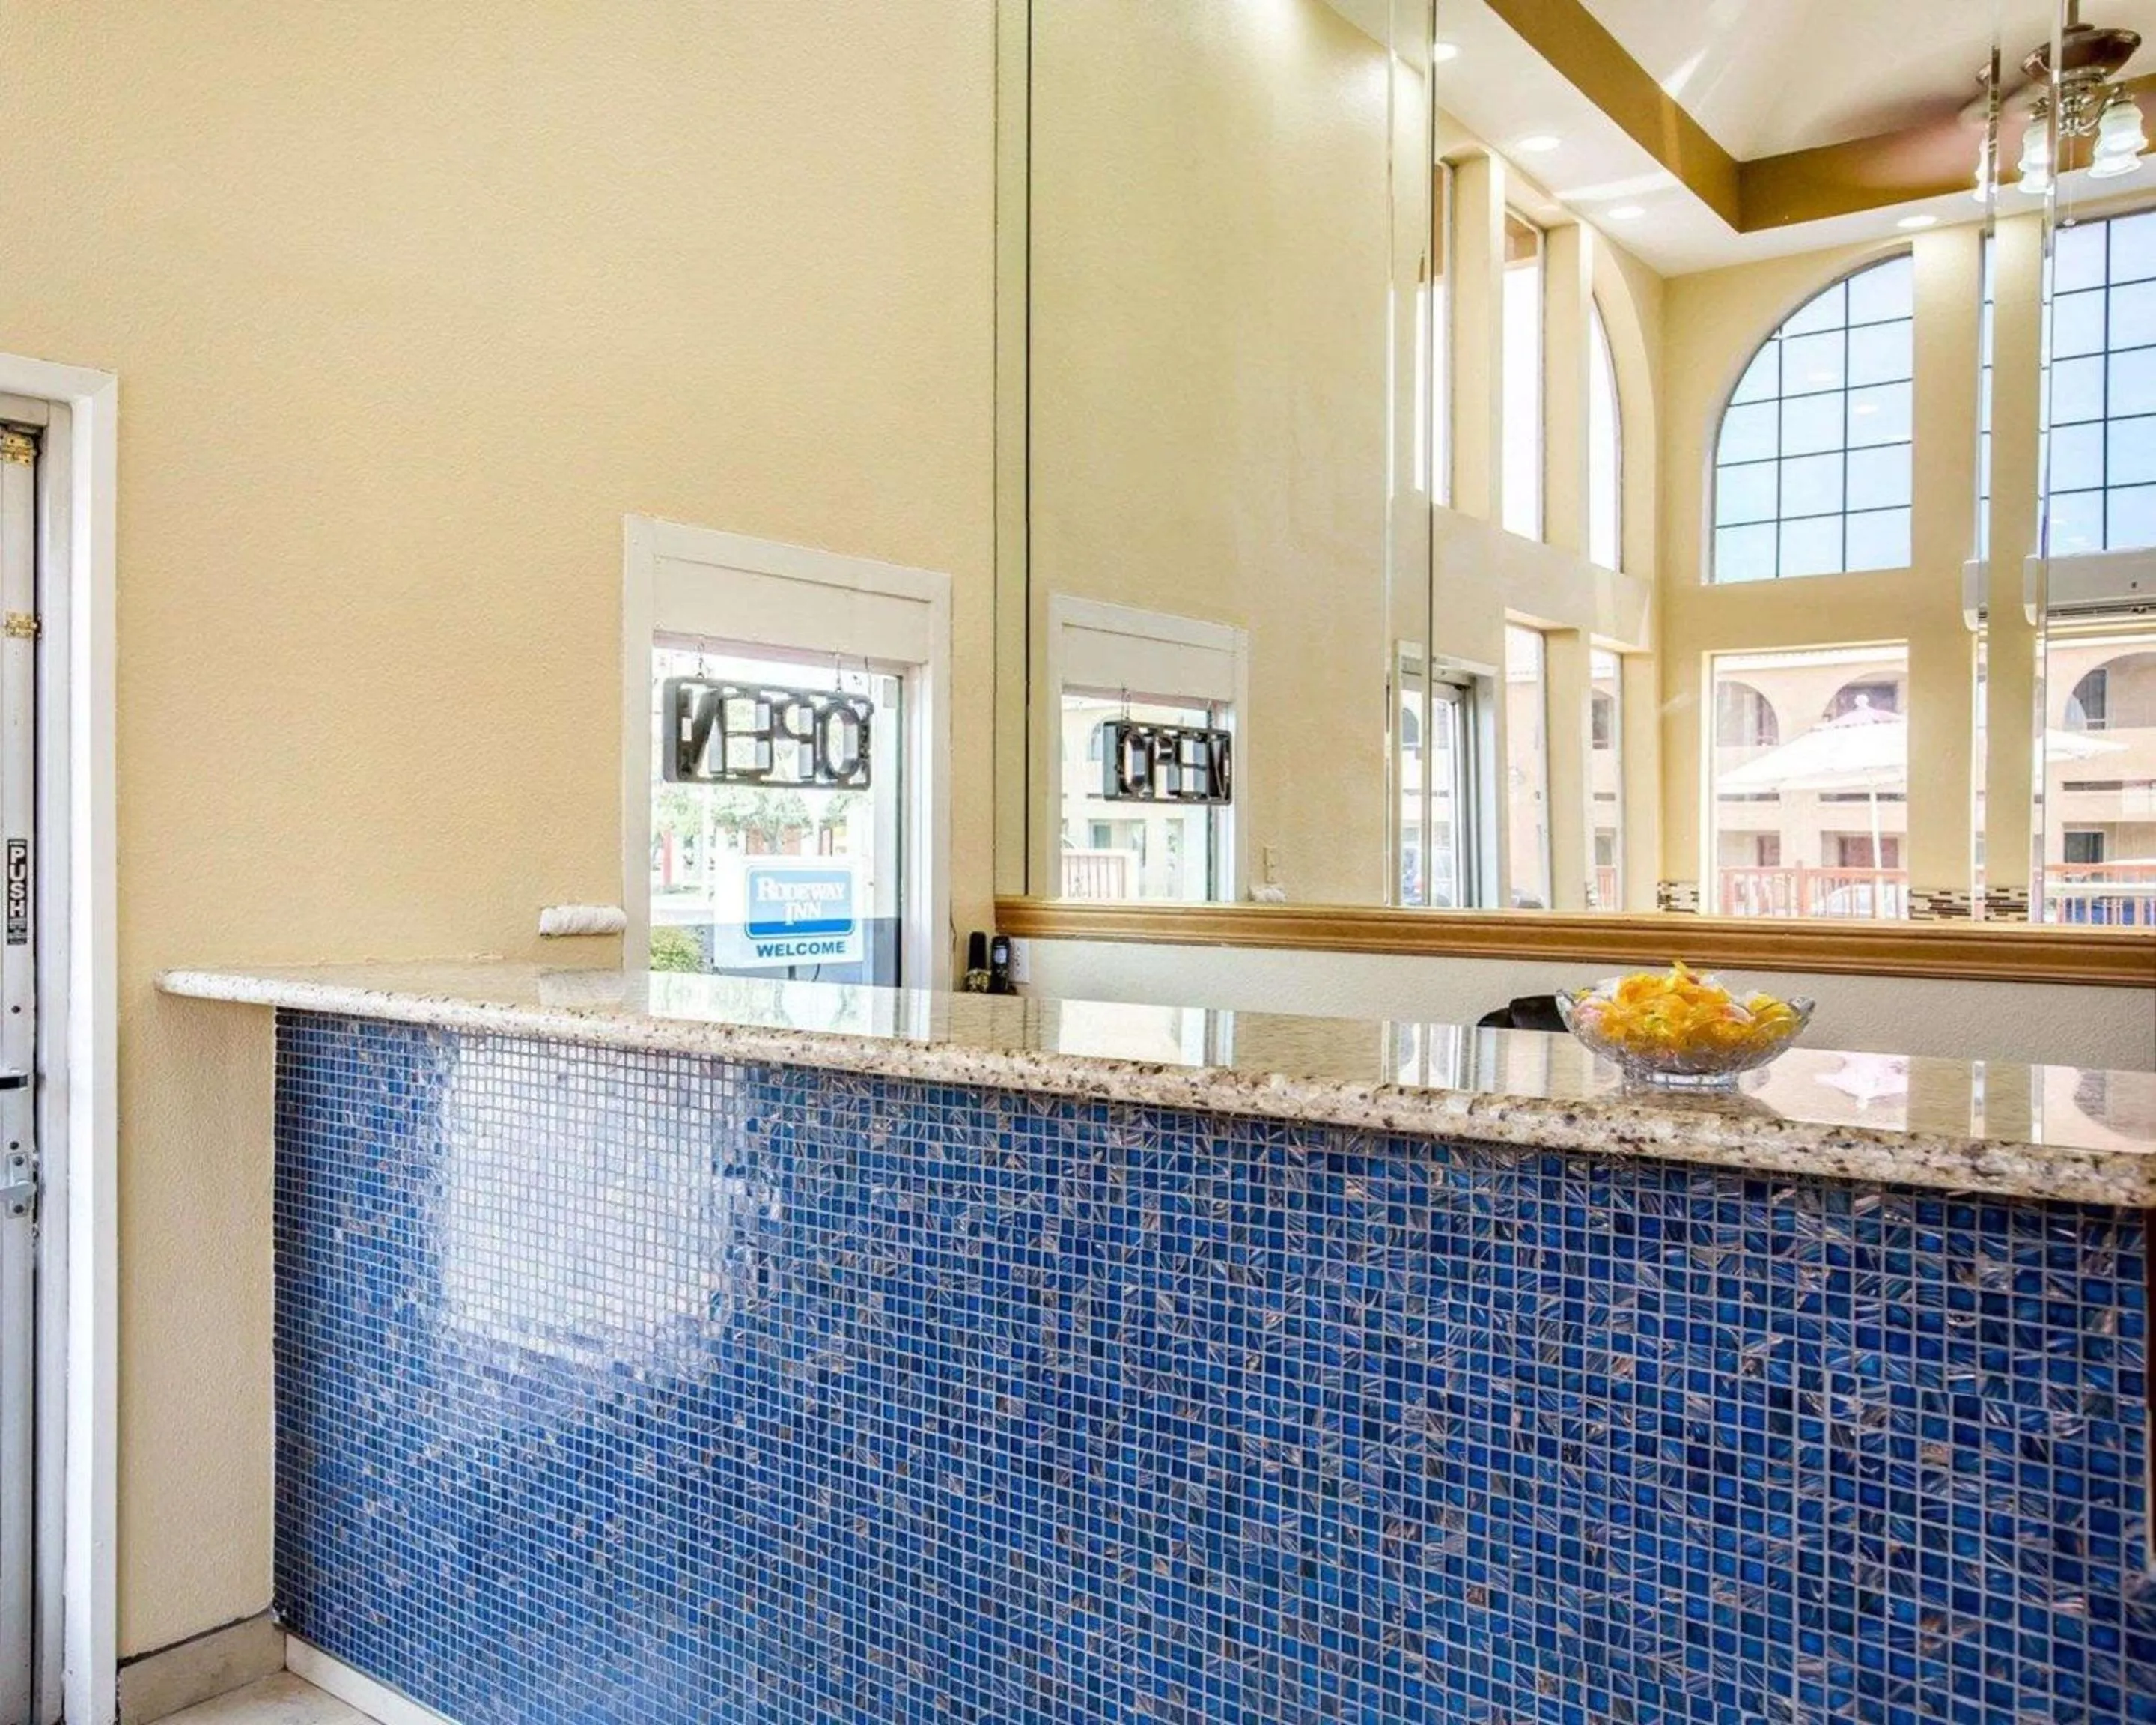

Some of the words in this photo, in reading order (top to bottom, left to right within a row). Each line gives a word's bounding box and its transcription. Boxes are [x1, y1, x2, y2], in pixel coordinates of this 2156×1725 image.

[10, 846, 25, 917] PUSH
[784, 900, 822, 925] INN
[756, 941, 846, 958] WELCOME
